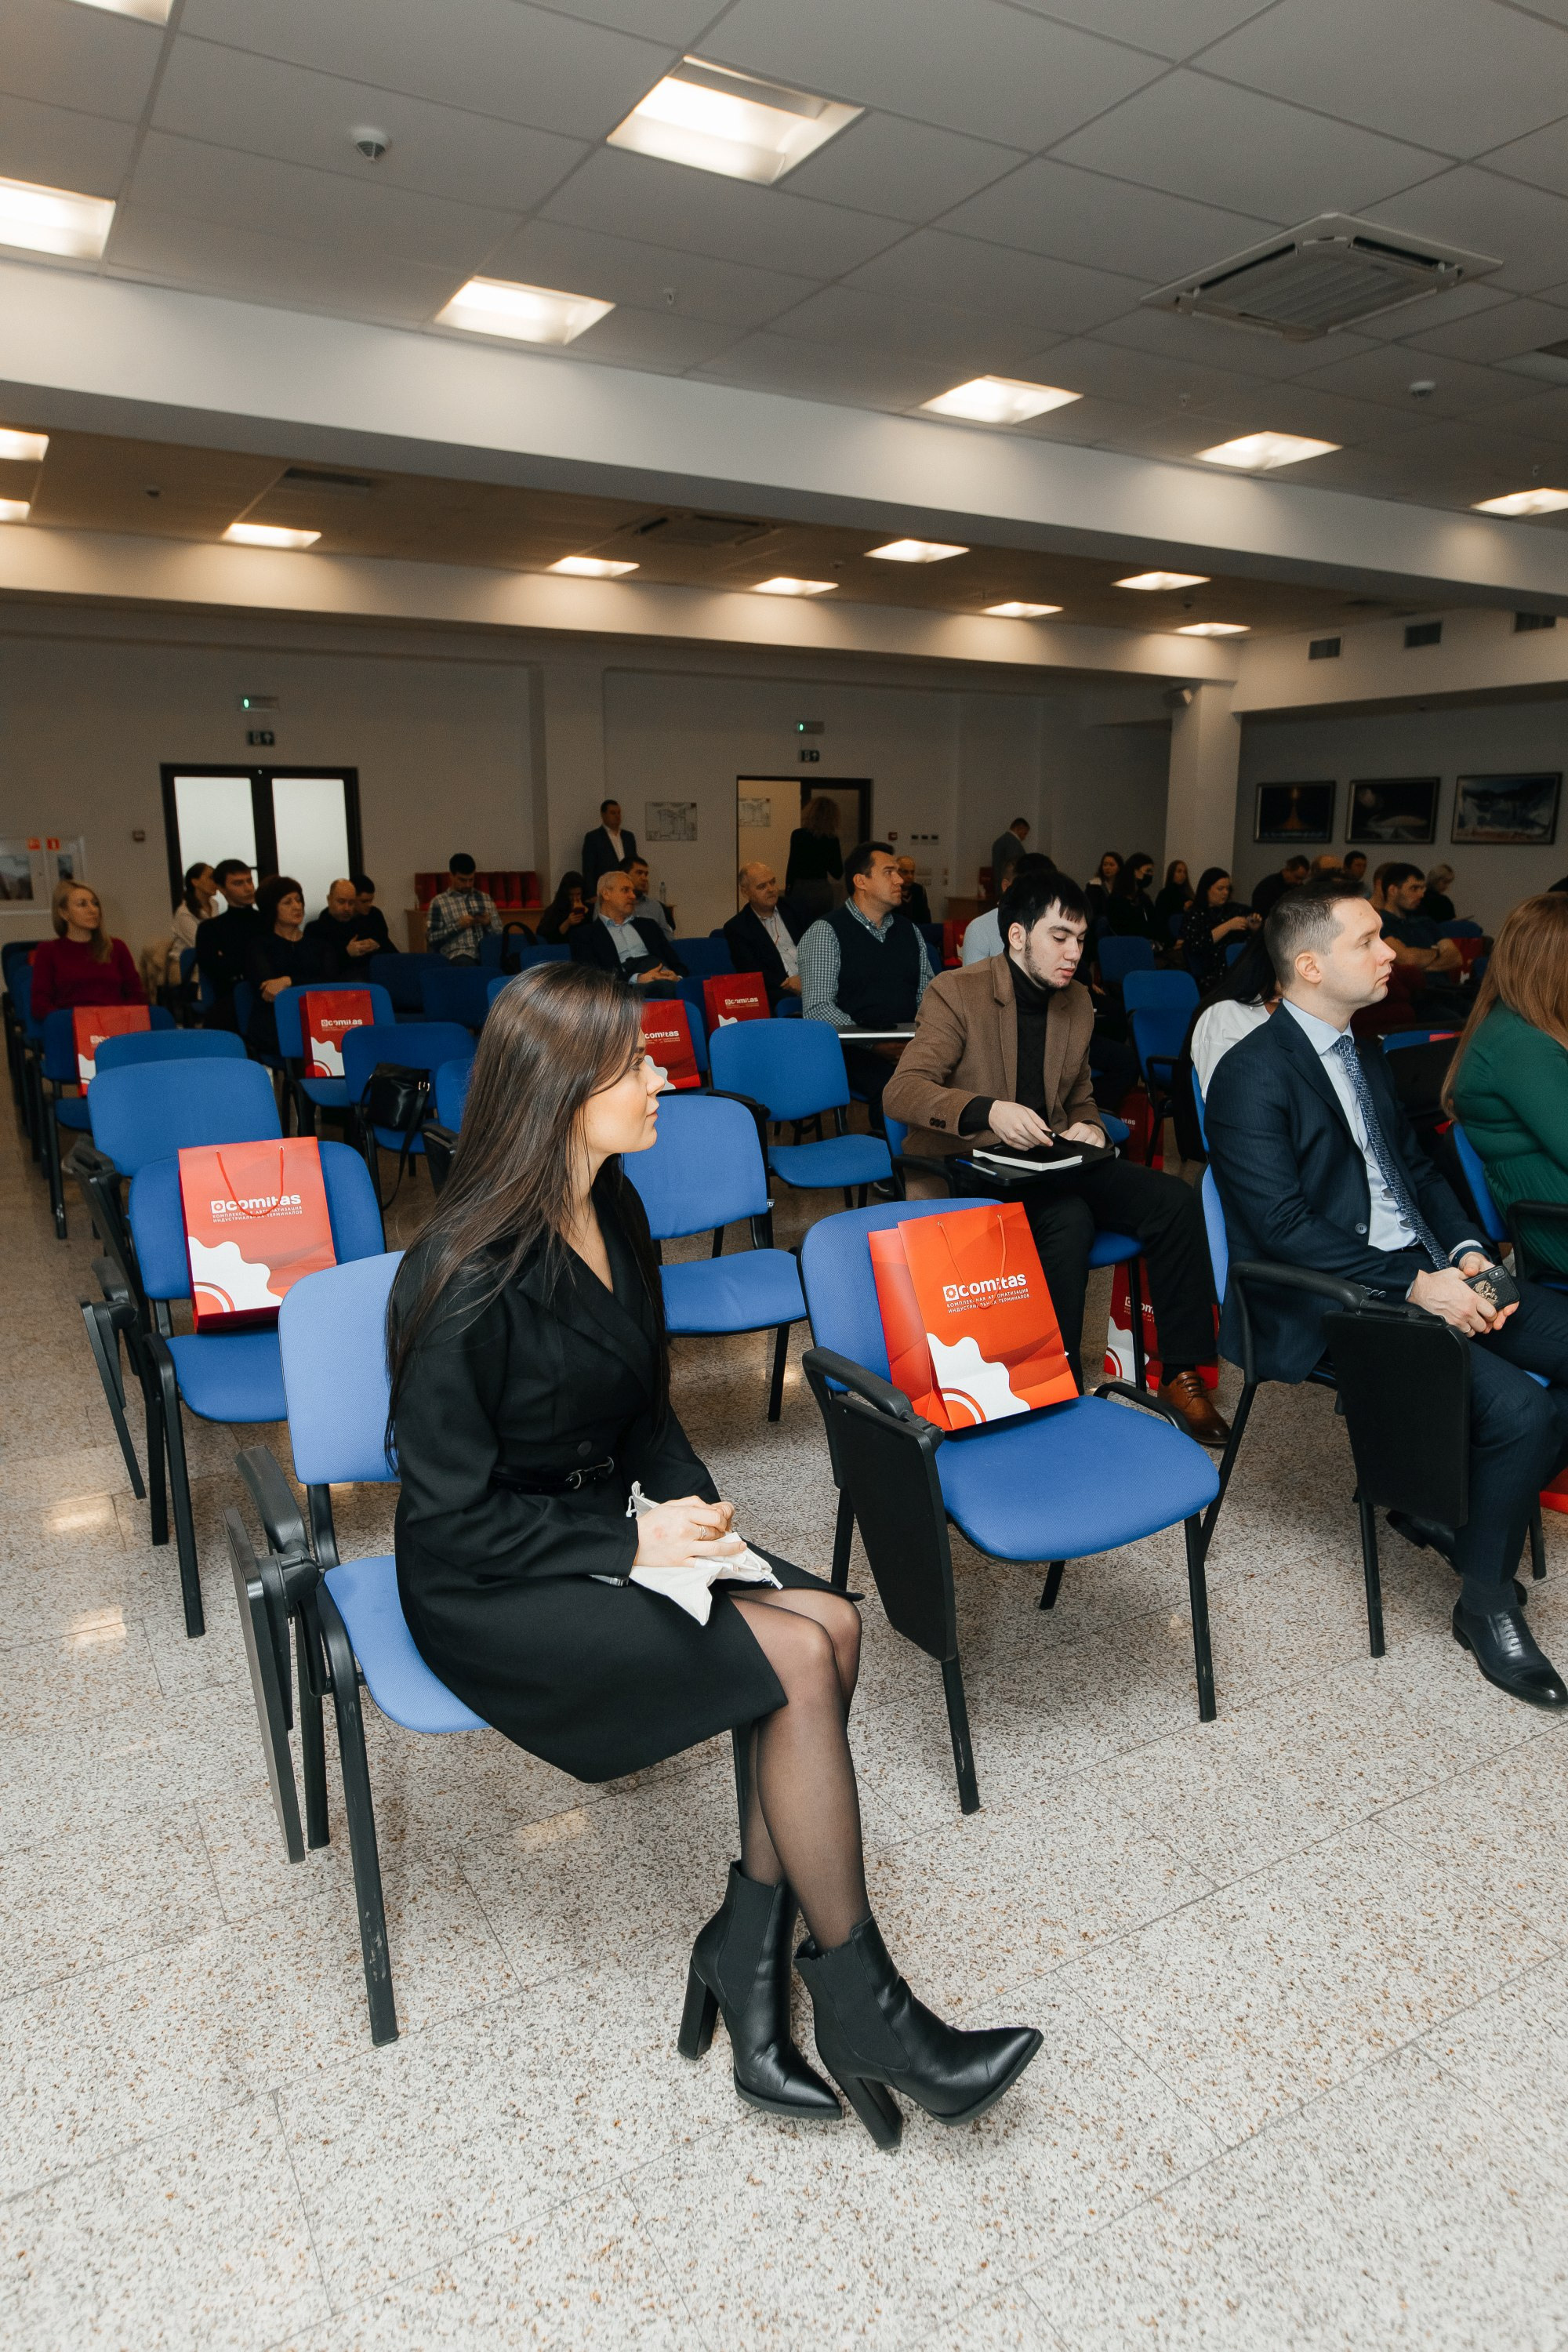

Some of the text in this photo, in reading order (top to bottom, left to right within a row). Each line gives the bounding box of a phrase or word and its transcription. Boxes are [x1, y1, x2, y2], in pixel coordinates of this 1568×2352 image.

[644, 1030, 680, 1039] comitas
[226, 1194, 302, 1211] comitas
[256, 1206, 303, 1214] АВТАТИЗАЦИЯ
[958, 1273, 1027, 1297] comitas
[988, 1287, 1029, 1300] АВОМАТИЗАЦИЯ
[948, 1294, 1030, 1314] ИНДУСТРИЛЬНХ ТЕРМИНАЛОВ
